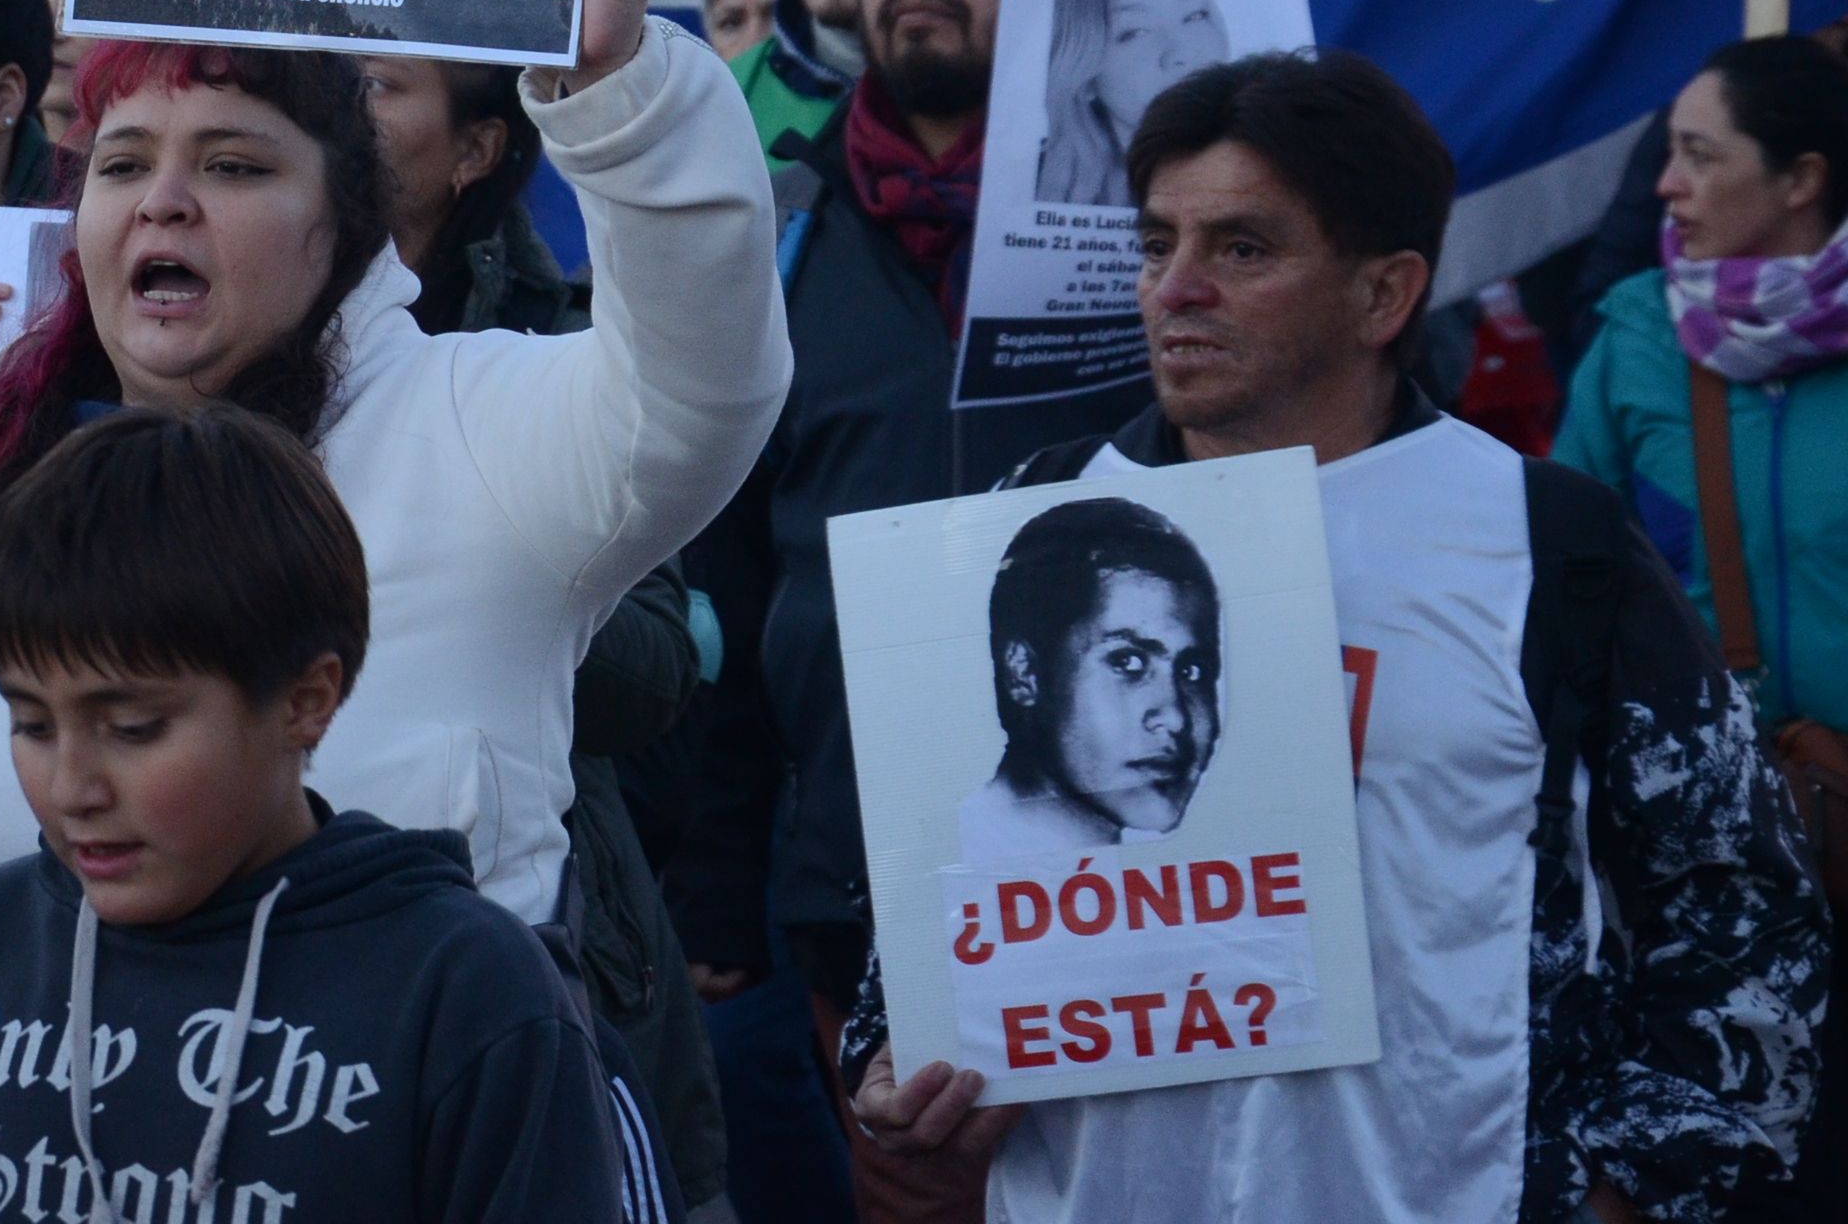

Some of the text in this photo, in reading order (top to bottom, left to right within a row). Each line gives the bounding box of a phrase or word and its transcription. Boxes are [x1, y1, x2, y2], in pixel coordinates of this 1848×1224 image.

[1005, 234, 1047, 248] tiene
[1052, 236, 1071, 249] 21
[953, 852, 1306, 965] ¿DÓNDE
[177, 1008, 381, 1137] The
[1002, 973, 1276, 1069] ESTÁ?
